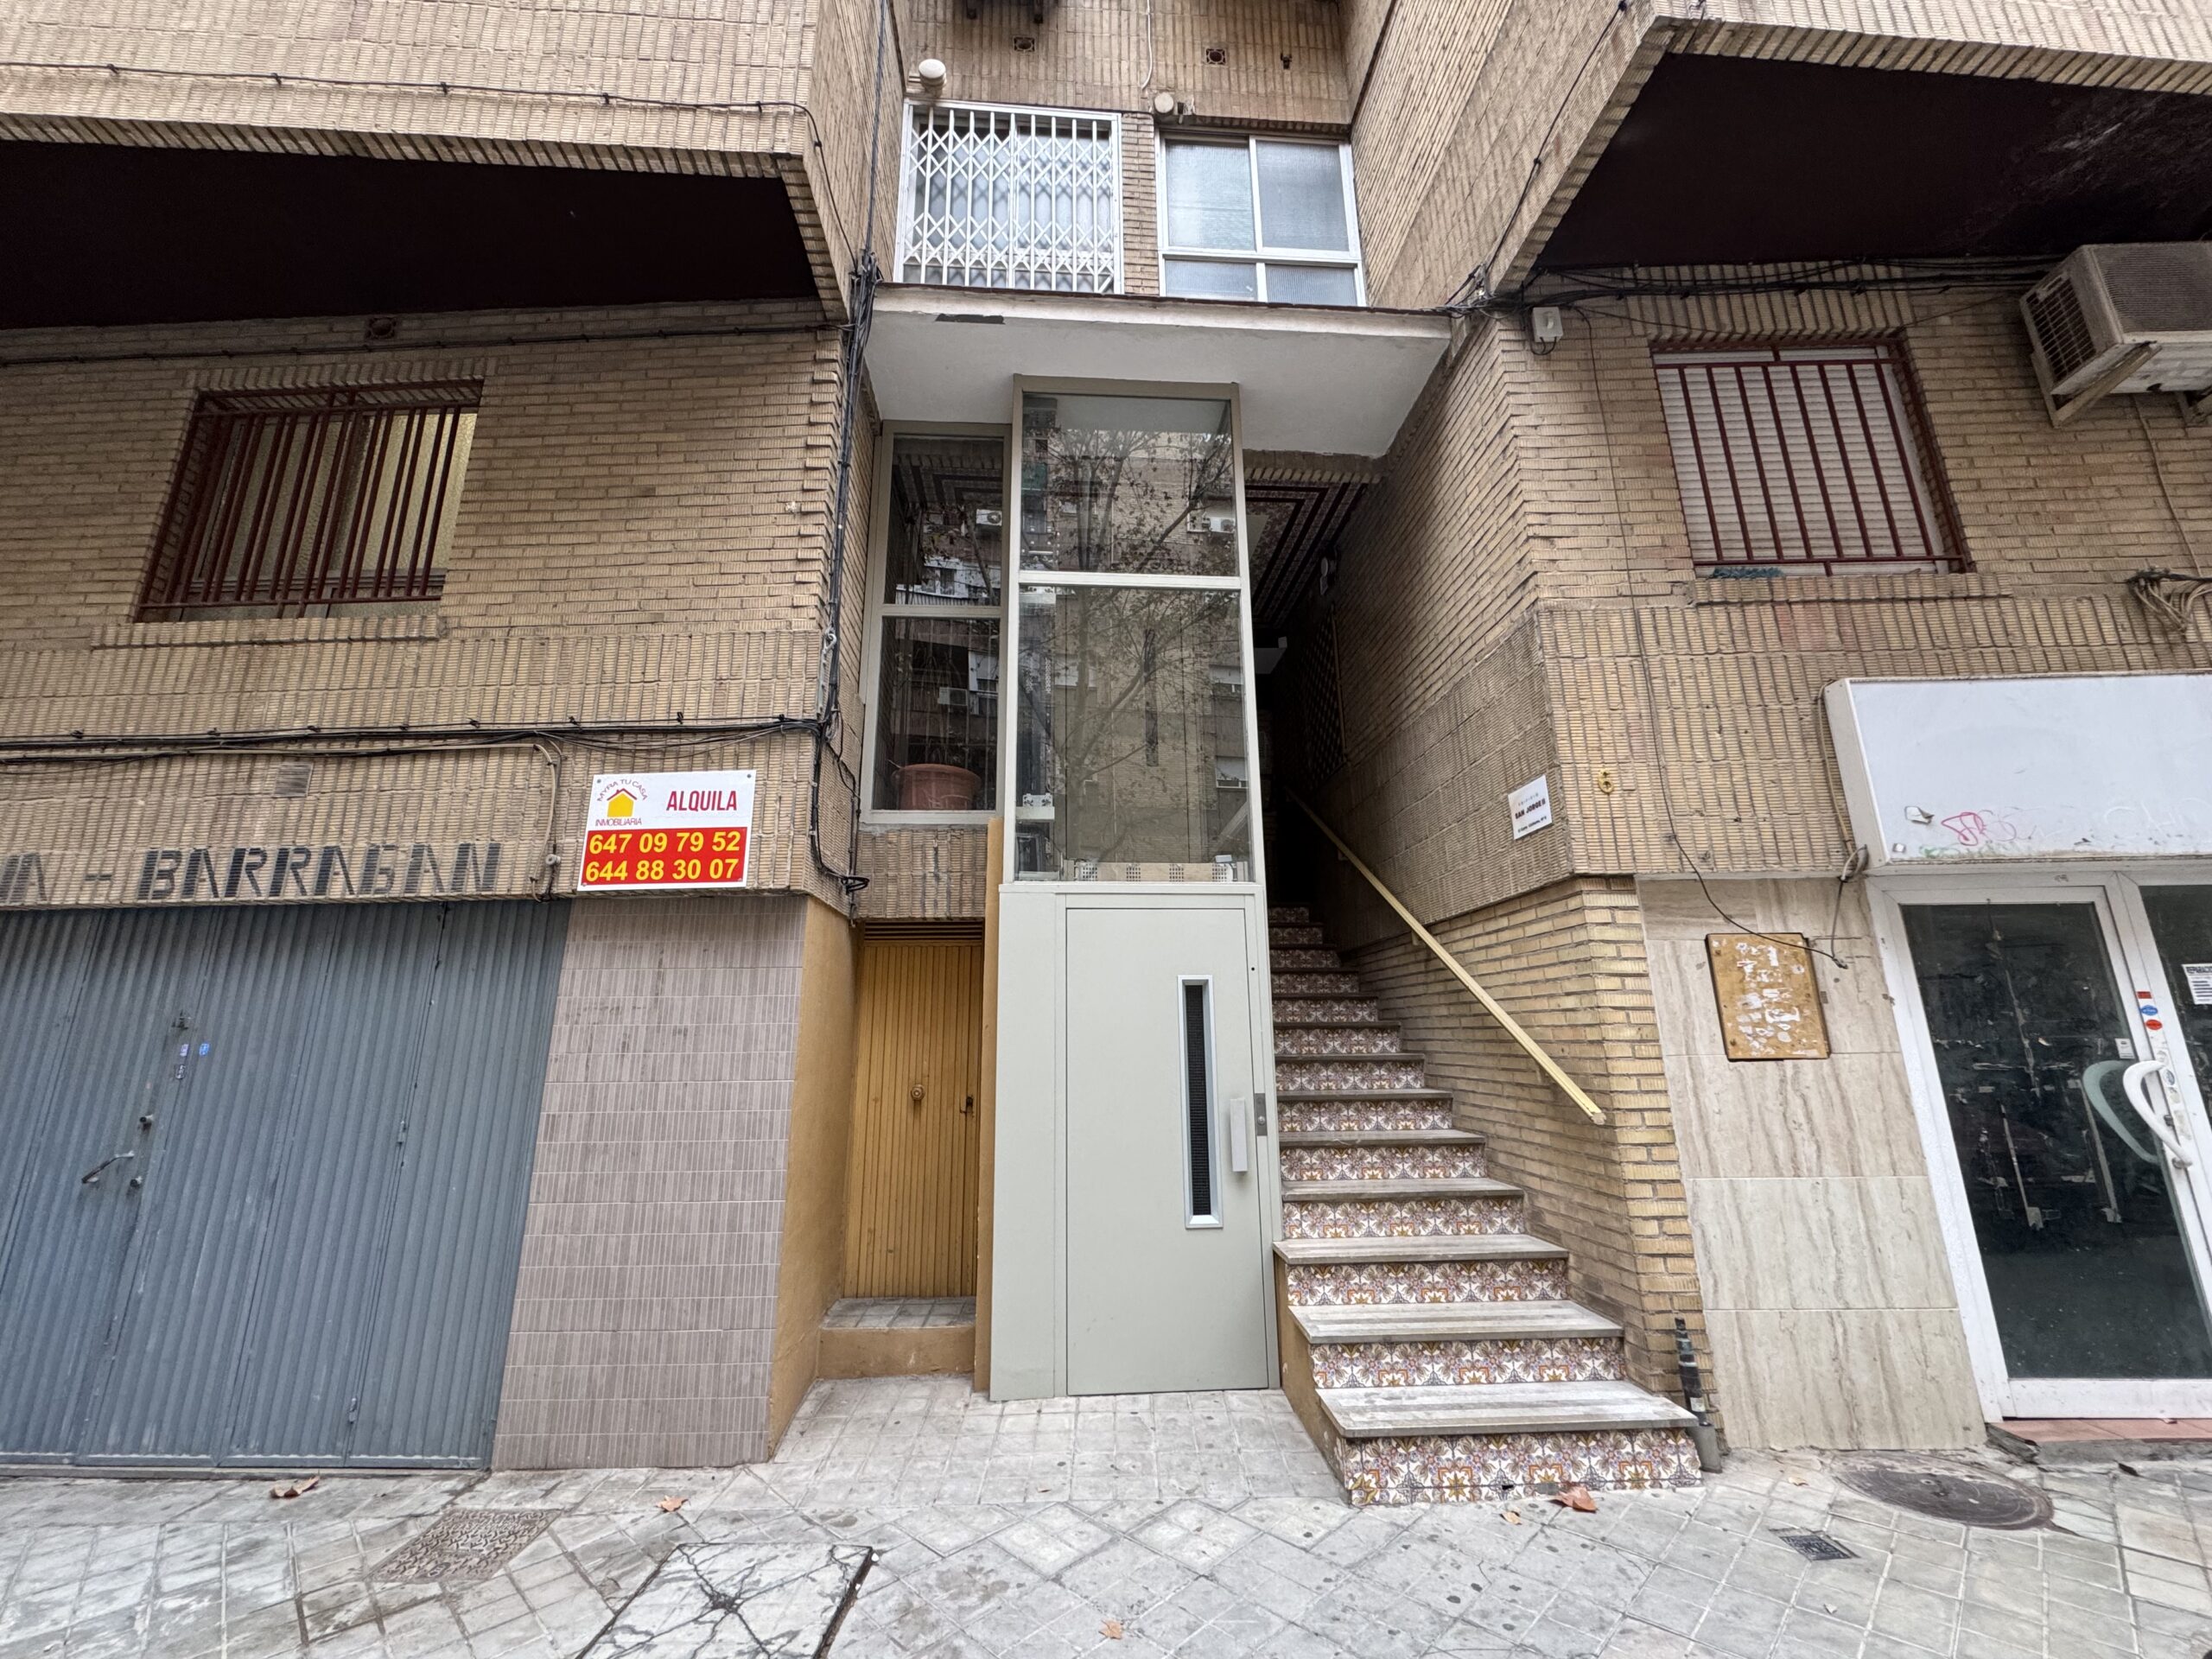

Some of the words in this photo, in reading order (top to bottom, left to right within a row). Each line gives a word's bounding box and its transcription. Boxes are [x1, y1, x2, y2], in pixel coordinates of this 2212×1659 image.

[632, 781, 648, 801] CASA
[666, 791, 737, 812] ALQUILA
[588, 833, 632, 855] 647
[639, 832, 668, 853] 09
[676, 831, 704, 852] 79
[711, 830, 741, 852] 52
[137, 842, 501, 901] BARRAGAN
[585, 861, 628, 881] 644
[635, 860, 664, 880] 88
[672, 859, 702, 880] 30
[709, 858, 739, 880] 07
